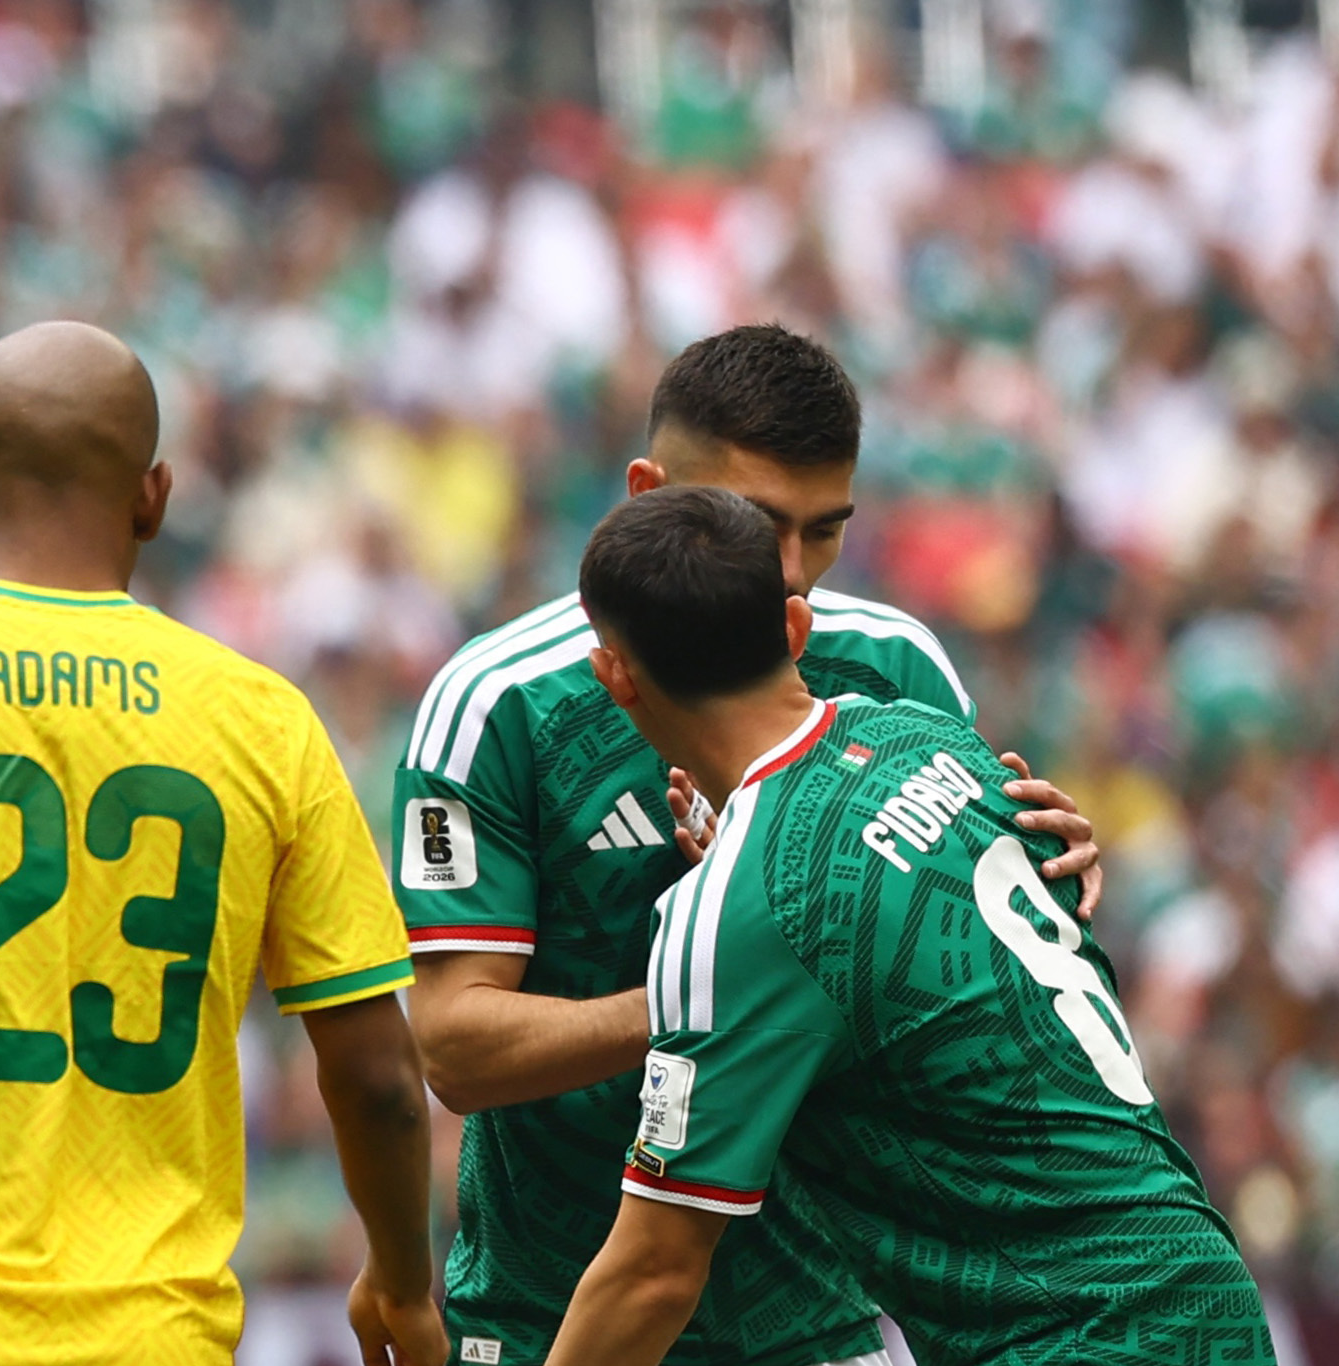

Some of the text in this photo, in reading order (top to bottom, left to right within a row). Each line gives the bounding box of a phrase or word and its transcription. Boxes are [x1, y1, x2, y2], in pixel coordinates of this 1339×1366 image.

[423, 872, 456, 882] 2026
[973, 836, 1154, 1106] 8
[644, 1106, 666, 1127] EACE
